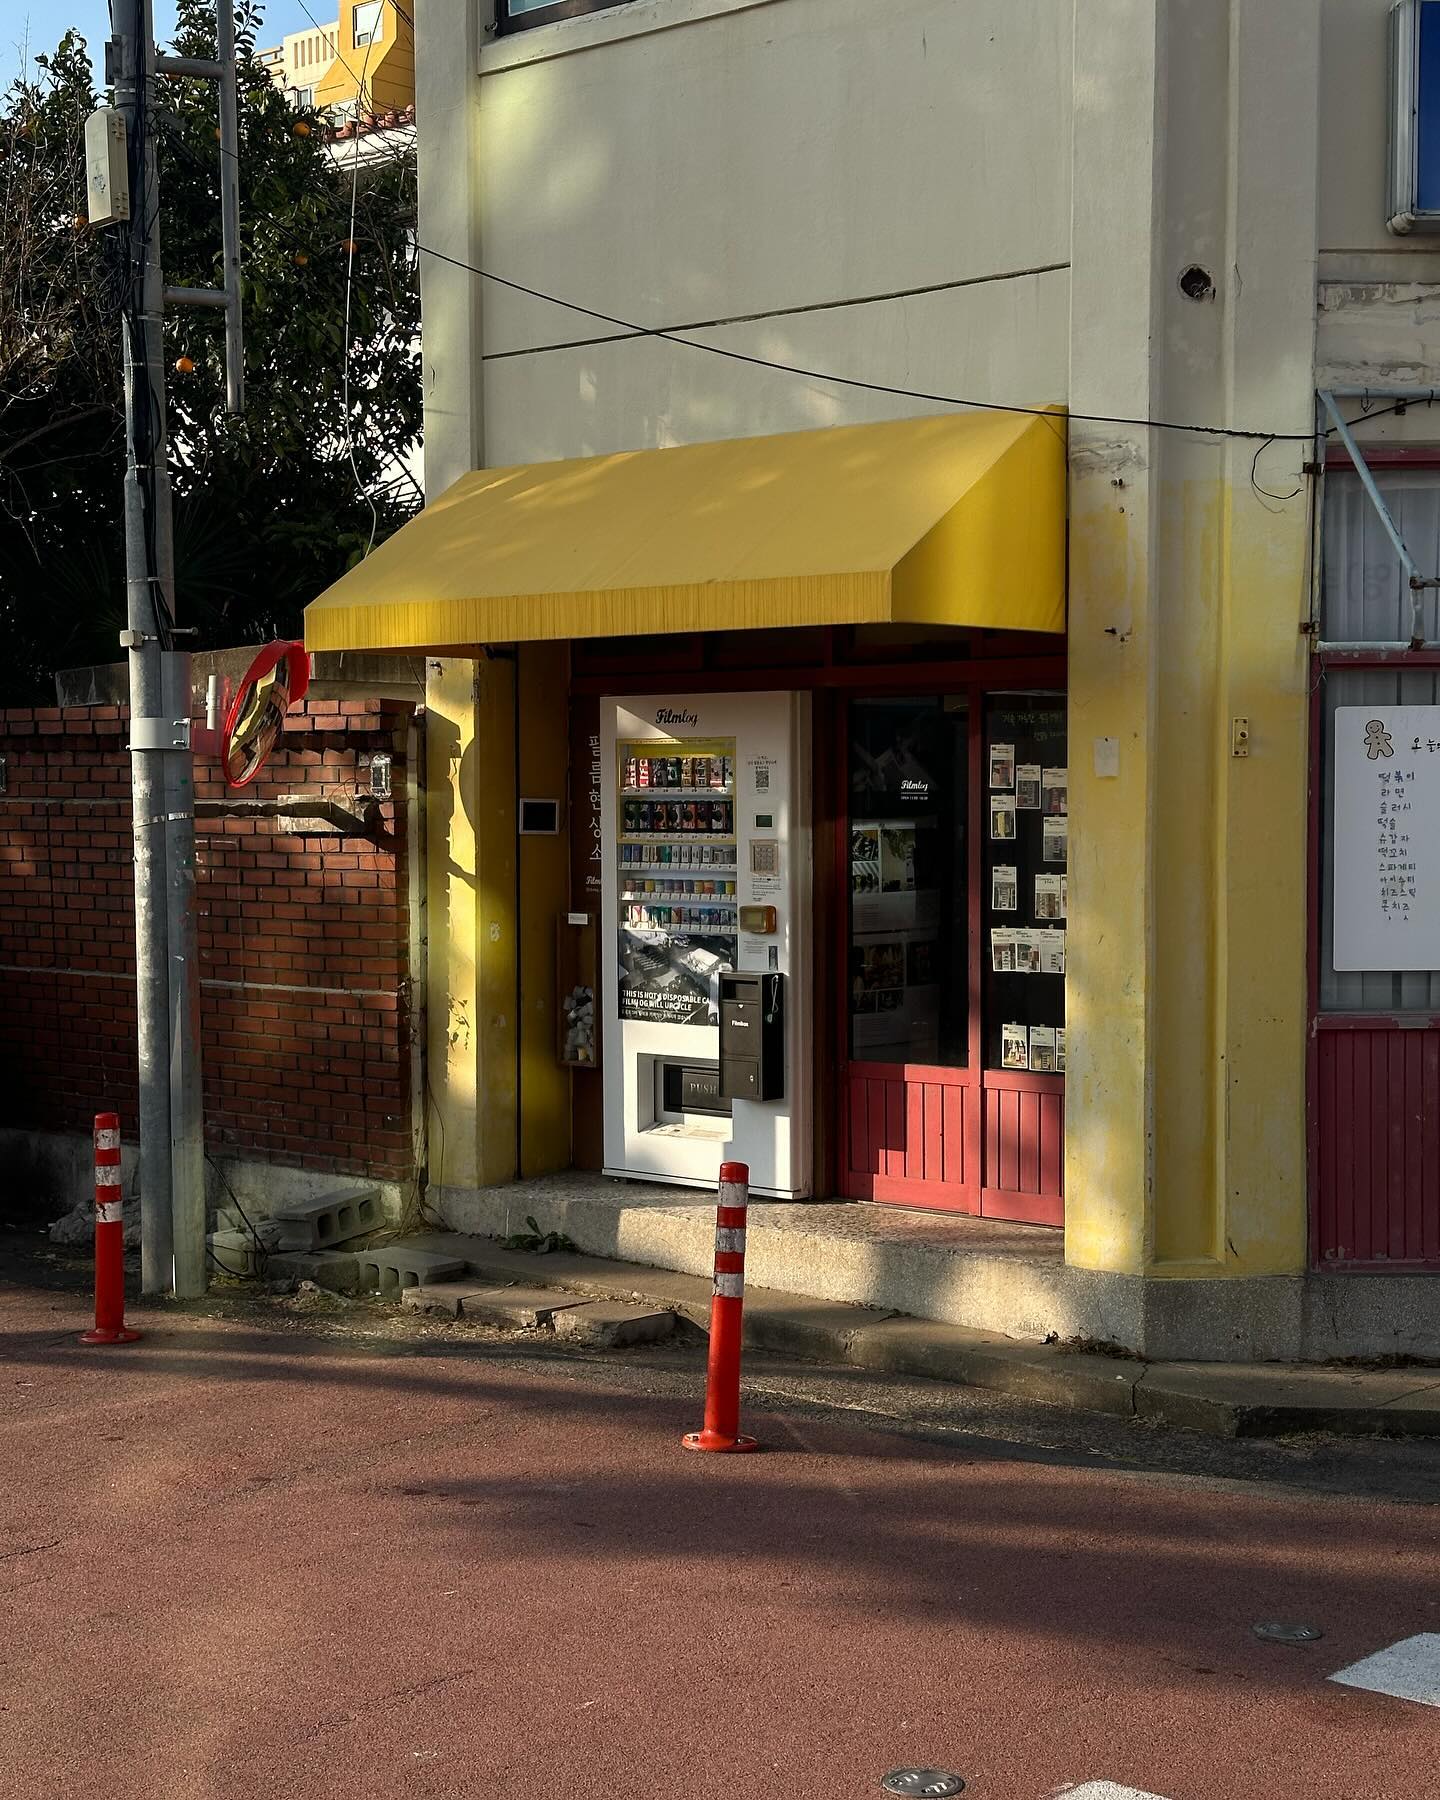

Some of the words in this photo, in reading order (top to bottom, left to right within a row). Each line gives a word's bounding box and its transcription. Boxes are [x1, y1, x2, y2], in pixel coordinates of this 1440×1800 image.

[655, 707, 698, 728] Filmlog
[1378, 770, 1415, 783] 떡볶이
[900, 779, 929, 792] Filmlog
[1381, 787, 1405, 798] 라면
[1379, 800, 1412, 815] 슬러시
[622, 989, 637, 998] THIS
[637, 990, 644, 998] IS
[644, 991, 657, 999] NOT
[662, 993, 701, 1004] DISPOSABLE
[690, 1082, 716, 1095] PUSH
